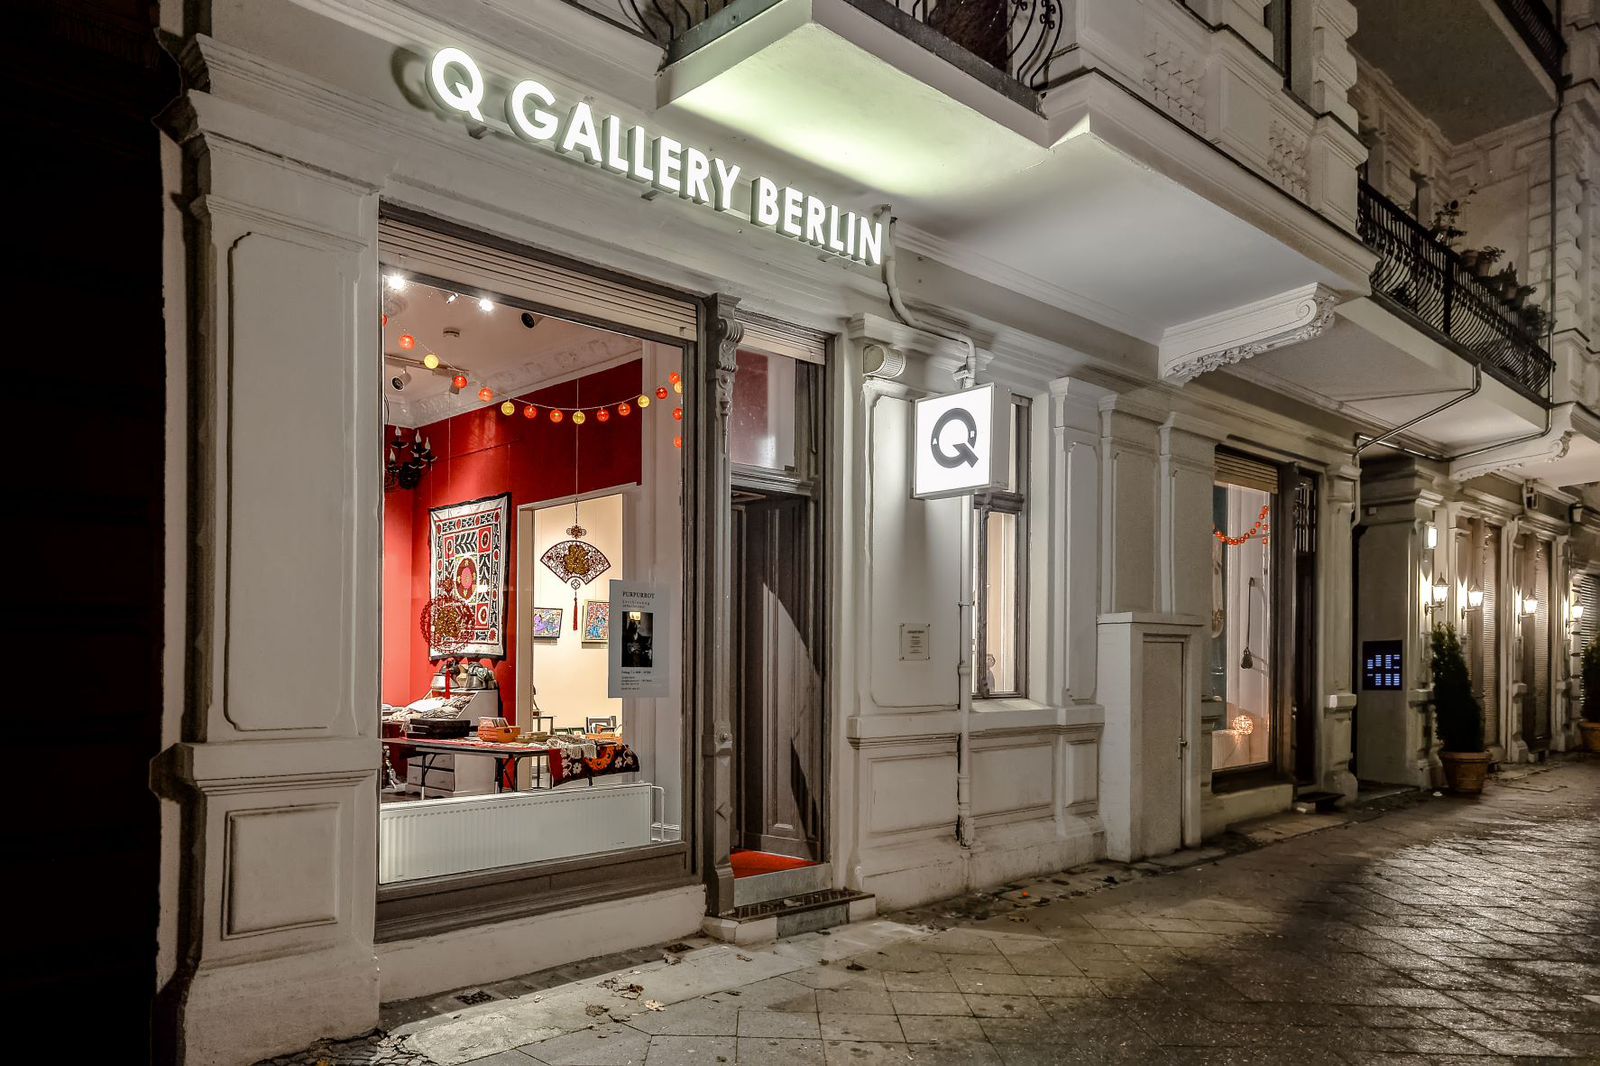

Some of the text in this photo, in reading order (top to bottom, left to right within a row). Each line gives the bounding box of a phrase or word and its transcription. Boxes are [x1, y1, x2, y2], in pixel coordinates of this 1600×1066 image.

[429, 47, 883, 266] Q GALLERY BERLIN
[930, 407, 979, 469] Q
